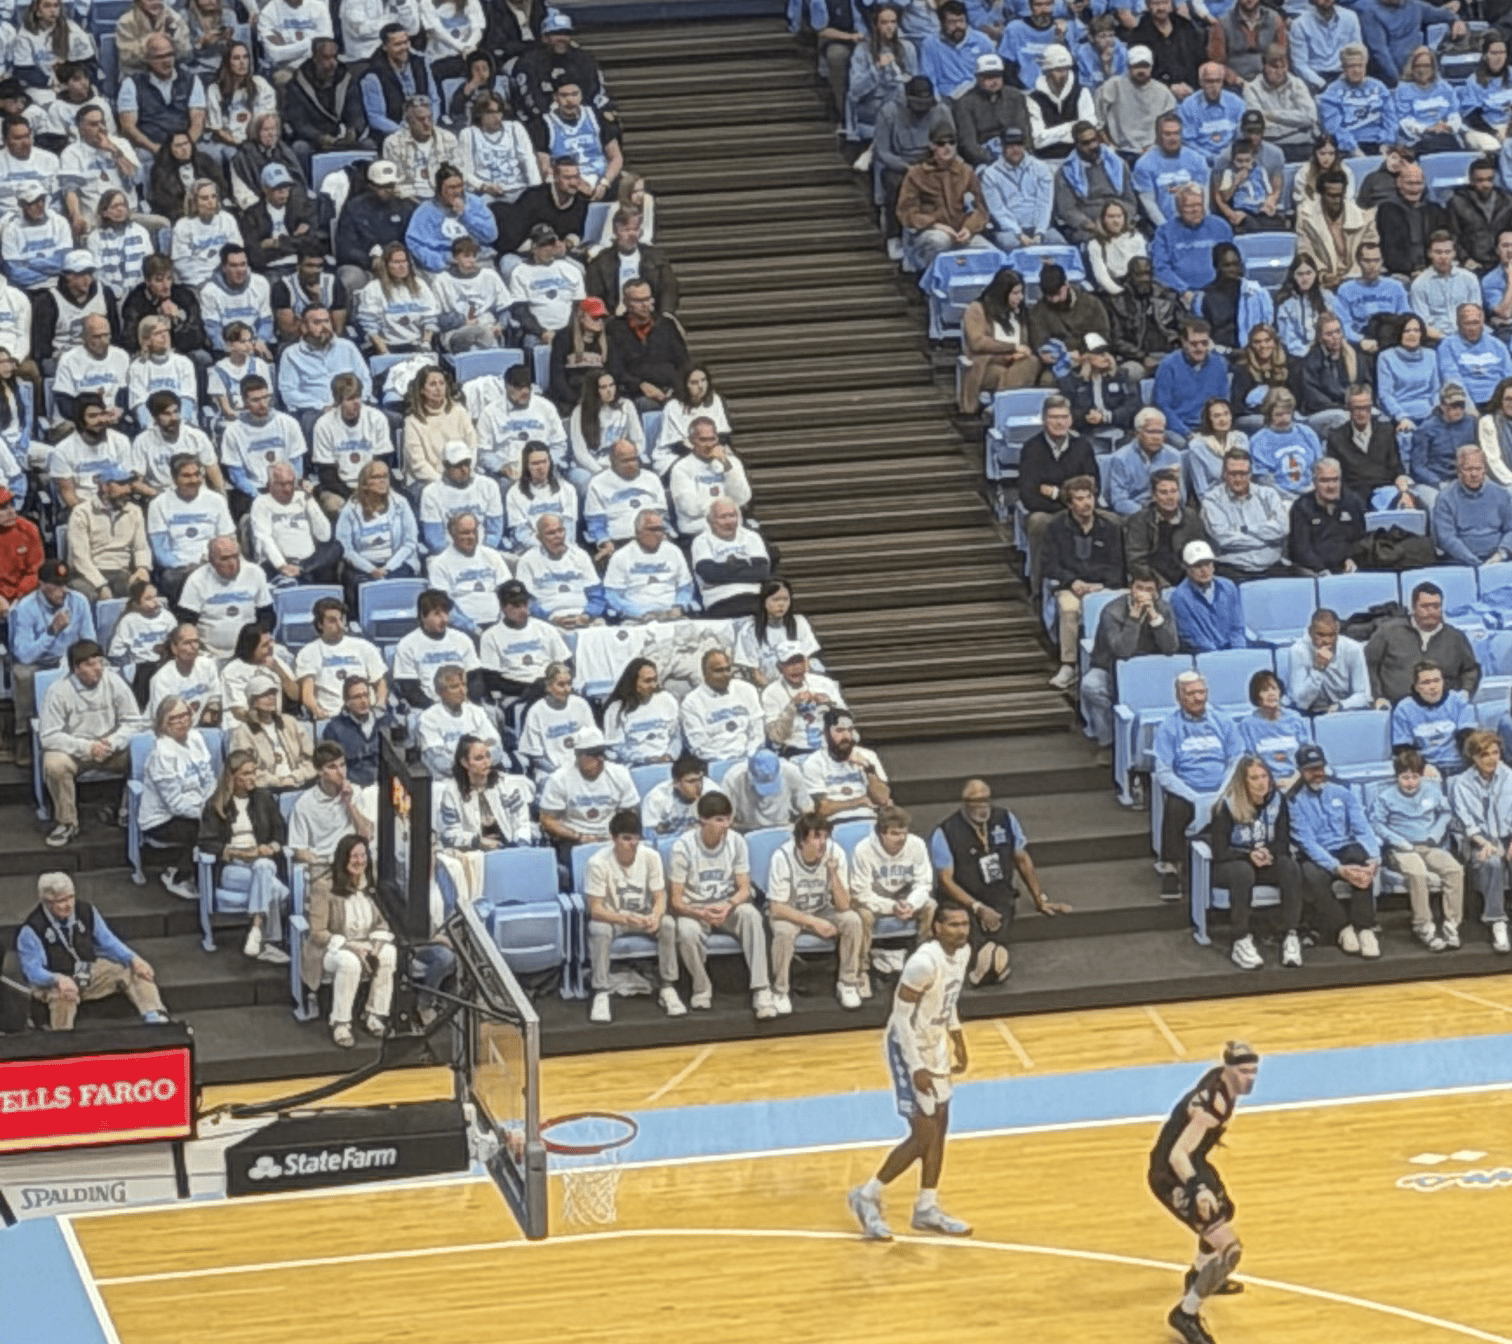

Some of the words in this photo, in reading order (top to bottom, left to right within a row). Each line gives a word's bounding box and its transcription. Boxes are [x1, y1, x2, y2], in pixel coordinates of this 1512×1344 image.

[0, 1085, 72, 1114] ELLS
[78, 1077, 177, 1109] FARGO
[20, 1182, 126, 1210] SPALDING
